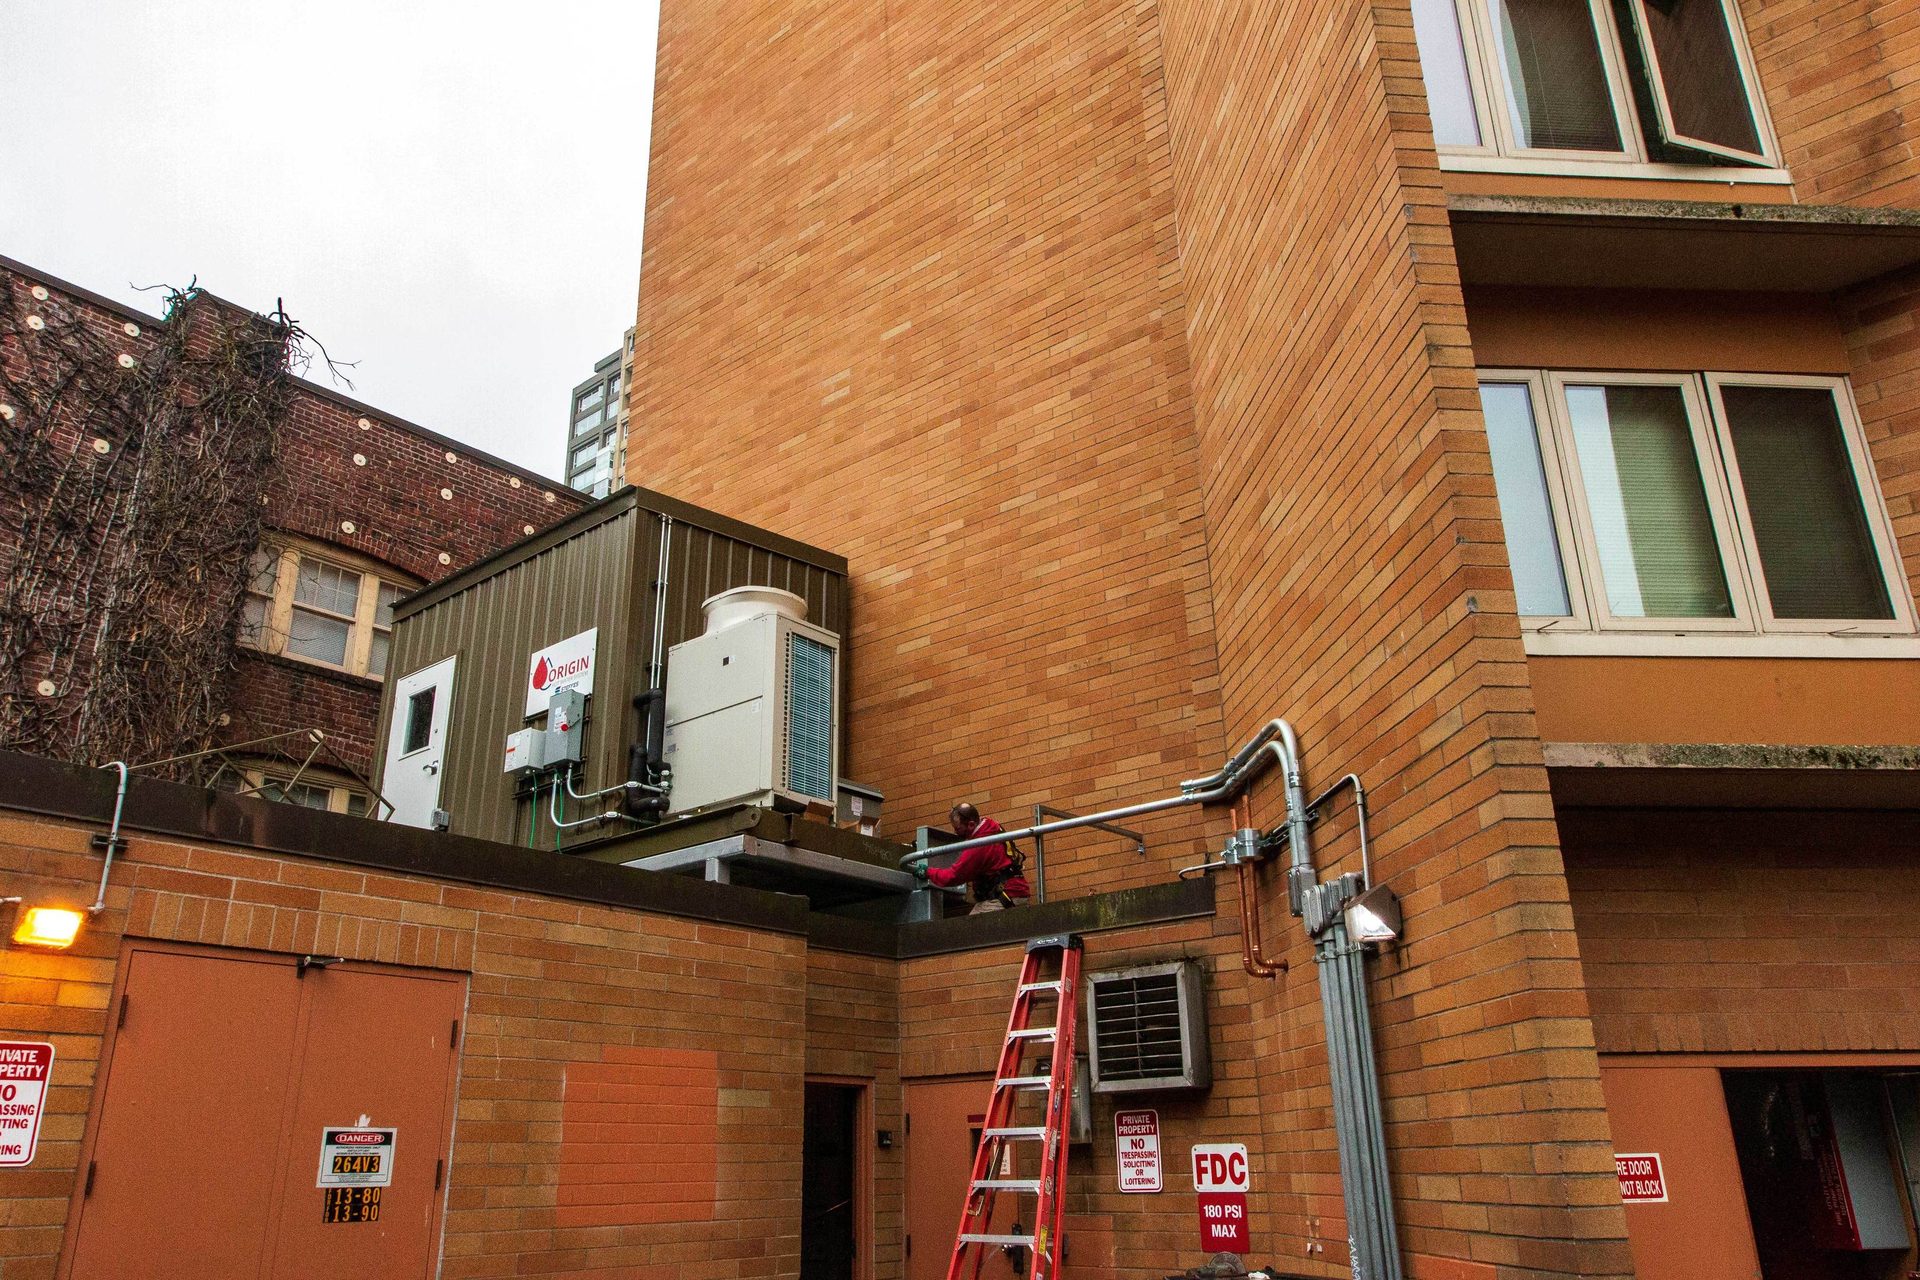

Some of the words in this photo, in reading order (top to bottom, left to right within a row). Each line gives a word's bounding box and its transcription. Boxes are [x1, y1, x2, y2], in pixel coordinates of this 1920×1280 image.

[549, 656, 589, 682] ORIGIN
[0, 1049, 39, 1063] IVATE
[1122, 1114, 1150, 1125] PRIVATE
[1118, 1124, 1155, 1135] PROPERTY
[0, 1145, 22, 1156] ING
[1130, 1138, 1145, 1150] NO
[1121, 1151, 1157, 1160] TRESPASSING
[333, 1156, 379, 1173] 264V3
[1123, 1160, 1156, 1168] SOLICITING
[1195, 1152, 1246, 1185] FDC
[1628, 1160, 1653, 1176] DOOR
[1135, 1168, 1144, 1176] OR
[1125, 1177, 1156, 1186] LOITERING
[1620, 1181, 1635, 1196] NOT
[1635, 1180, 1662, 1195] BLOCK
[335, 1187, 381, 1205] 13-80
[333, 1205, 379, 1222] 13-90
[1203, 1205, 1222, 1218] 180
[1224, 1205, 1242, 1218] PSI
[1211, 1224, 1237, 1238] MAX
